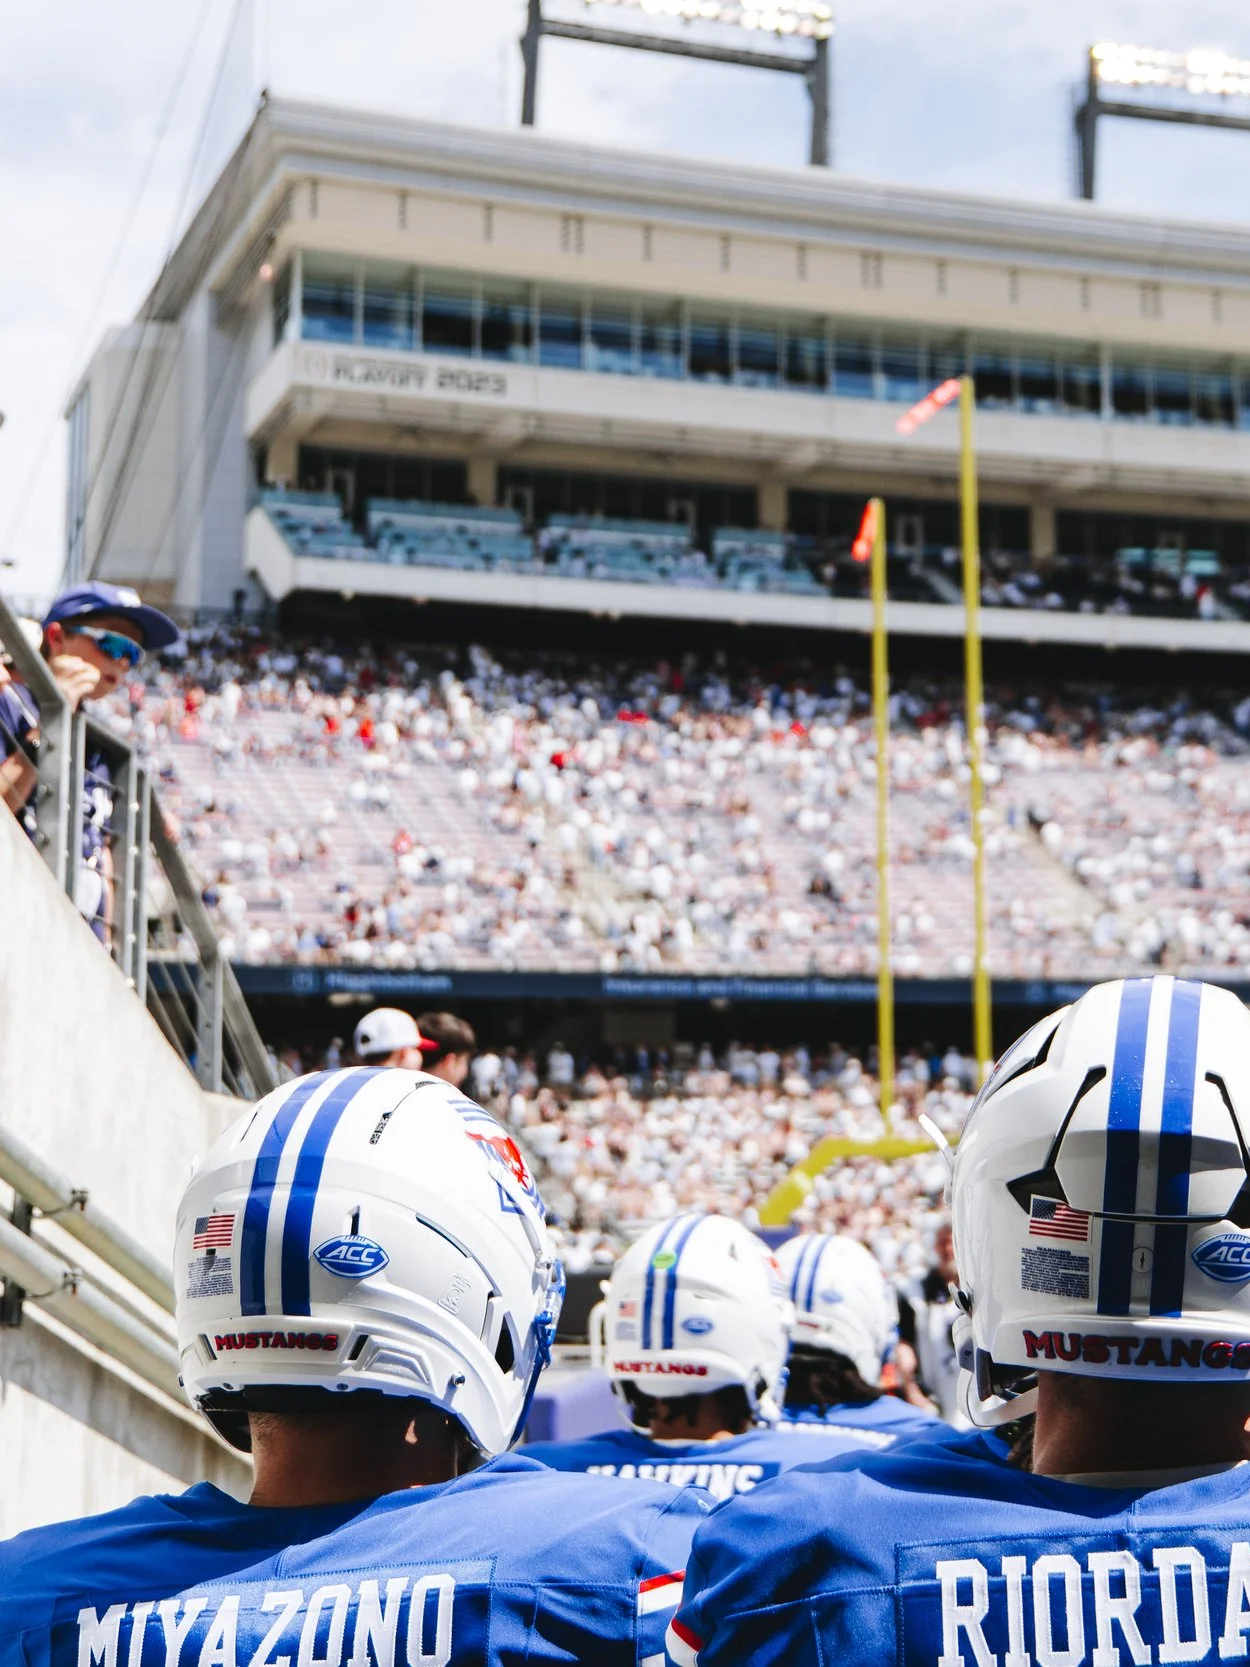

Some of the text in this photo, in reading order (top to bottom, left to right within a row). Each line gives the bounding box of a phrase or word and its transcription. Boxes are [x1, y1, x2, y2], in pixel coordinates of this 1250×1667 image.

[325, 1245, 380, 1262] ACC
[214, 1331, 339, 1352] MUSTANGS
[586, 1464, 763, 1500] KINS
[77, 1573, 455, 1667] MIYAZONO
